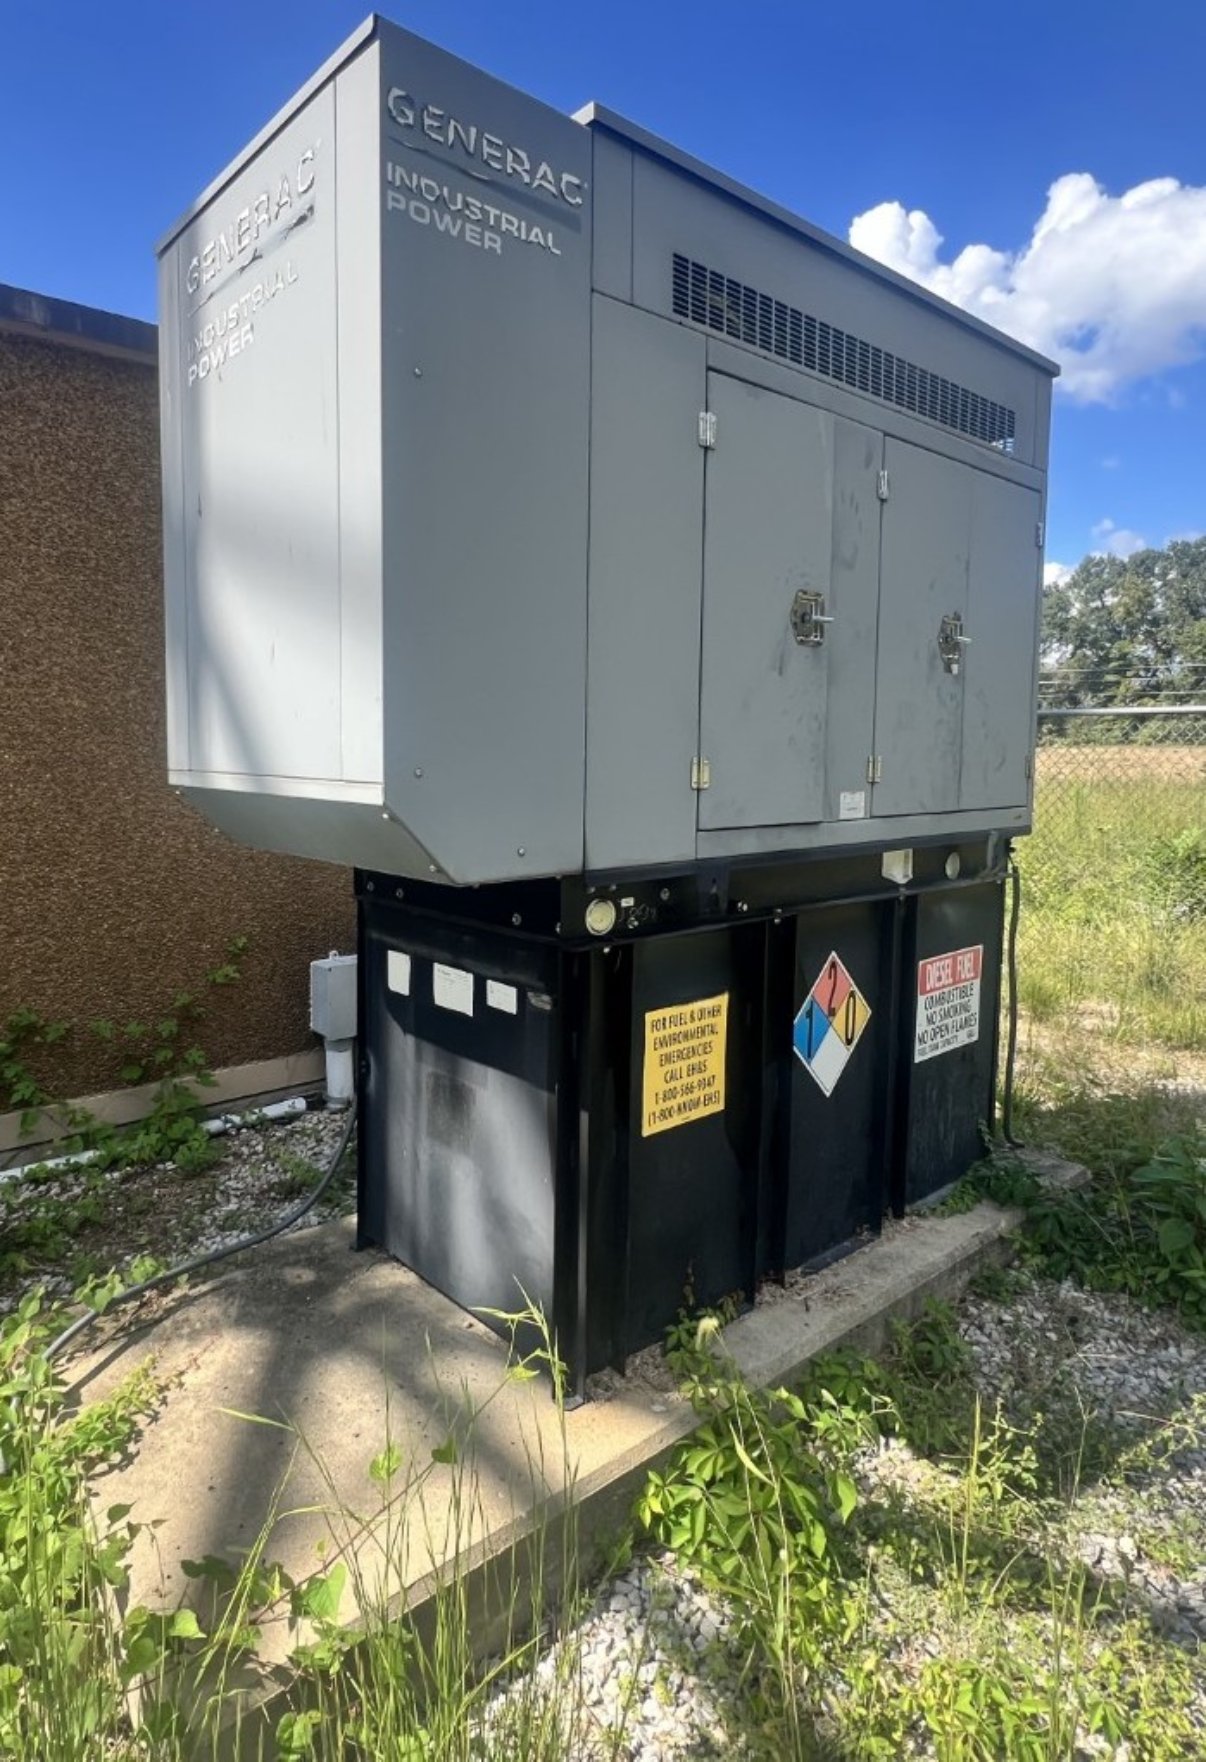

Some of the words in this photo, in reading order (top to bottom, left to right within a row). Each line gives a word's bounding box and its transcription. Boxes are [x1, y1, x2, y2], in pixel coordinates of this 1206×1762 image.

[387, 87, 583, 205] GENERAC
[187, 148, 315, 294] GENERAC
[387, 161, 561, 255] INDUSTRIAL
[387, 189, 501, 254] POWER
[187, 261, 299, 361] INDUSTRIAL
[188, 321, 255, 387] POWER
[828, 960, 838, 1017] 2
[924, 982, 974, 1011] COMBUSTIBLE
[926, 957, 953, 992] DIESEL
[956, 951, 975, 981] FUEL
[651, 1017, 667, 1033] FOR
[669, 1012, 688, 1029] FUEL
[689, 1010, 696, 1024] &
[697, 1004, 722, 1022] OTHER
[653, 1023, 719, 1052] ENVIRONMENTAL
[805, 1000, 814, 1059] 1
[845, 989, 857, 1046] 0
[918, 1029, 928, 1046] NO
[930, 1022, 950, 1041] OPEN
[926, 1010, 937, 1026] NO
[659, 1041, 713, 1068] EMERGENCIES
[664, 1066, 683, 1084] CALL
